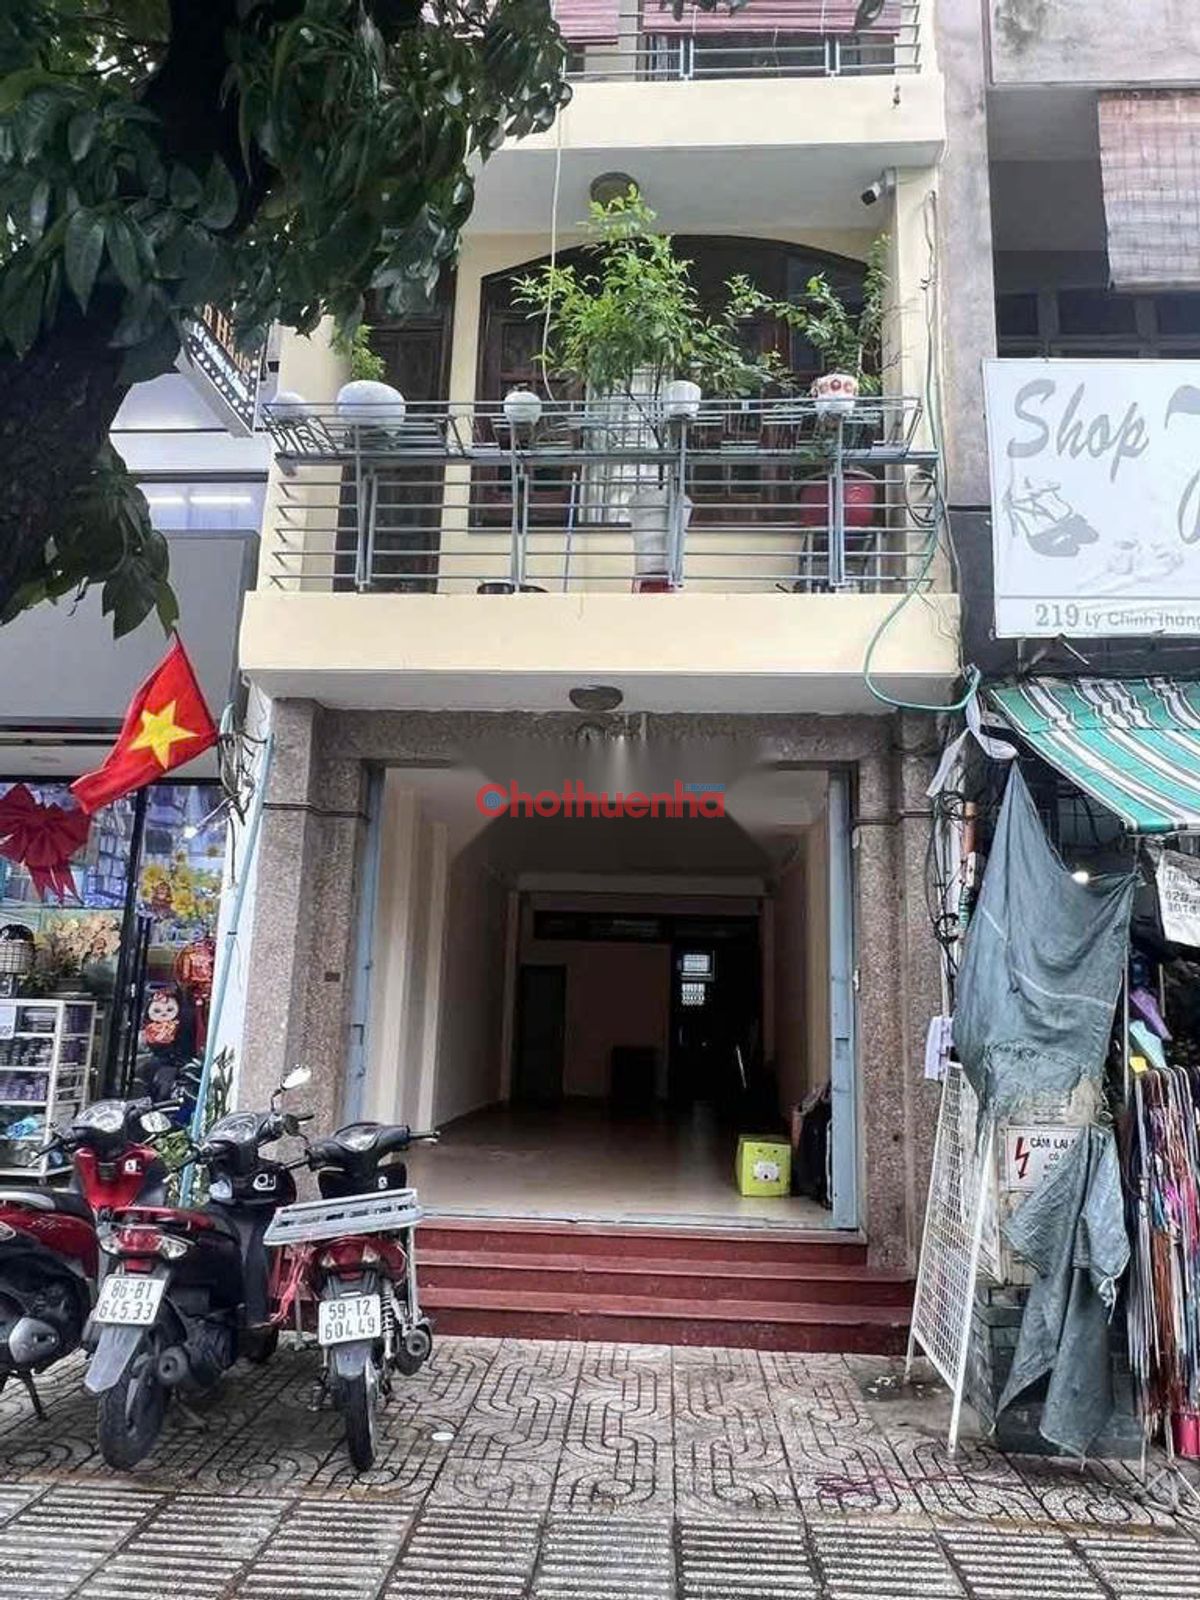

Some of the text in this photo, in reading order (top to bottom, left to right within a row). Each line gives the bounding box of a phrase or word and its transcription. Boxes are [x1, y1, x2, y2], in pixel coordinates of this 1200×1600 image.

[1007, 378, 1149, 482] Shop
[1035, 604, 1079, 628] 219
[111, 1280, 152, 1299] 86-B1
[328, 1299, 371, 1321] 59-T2
